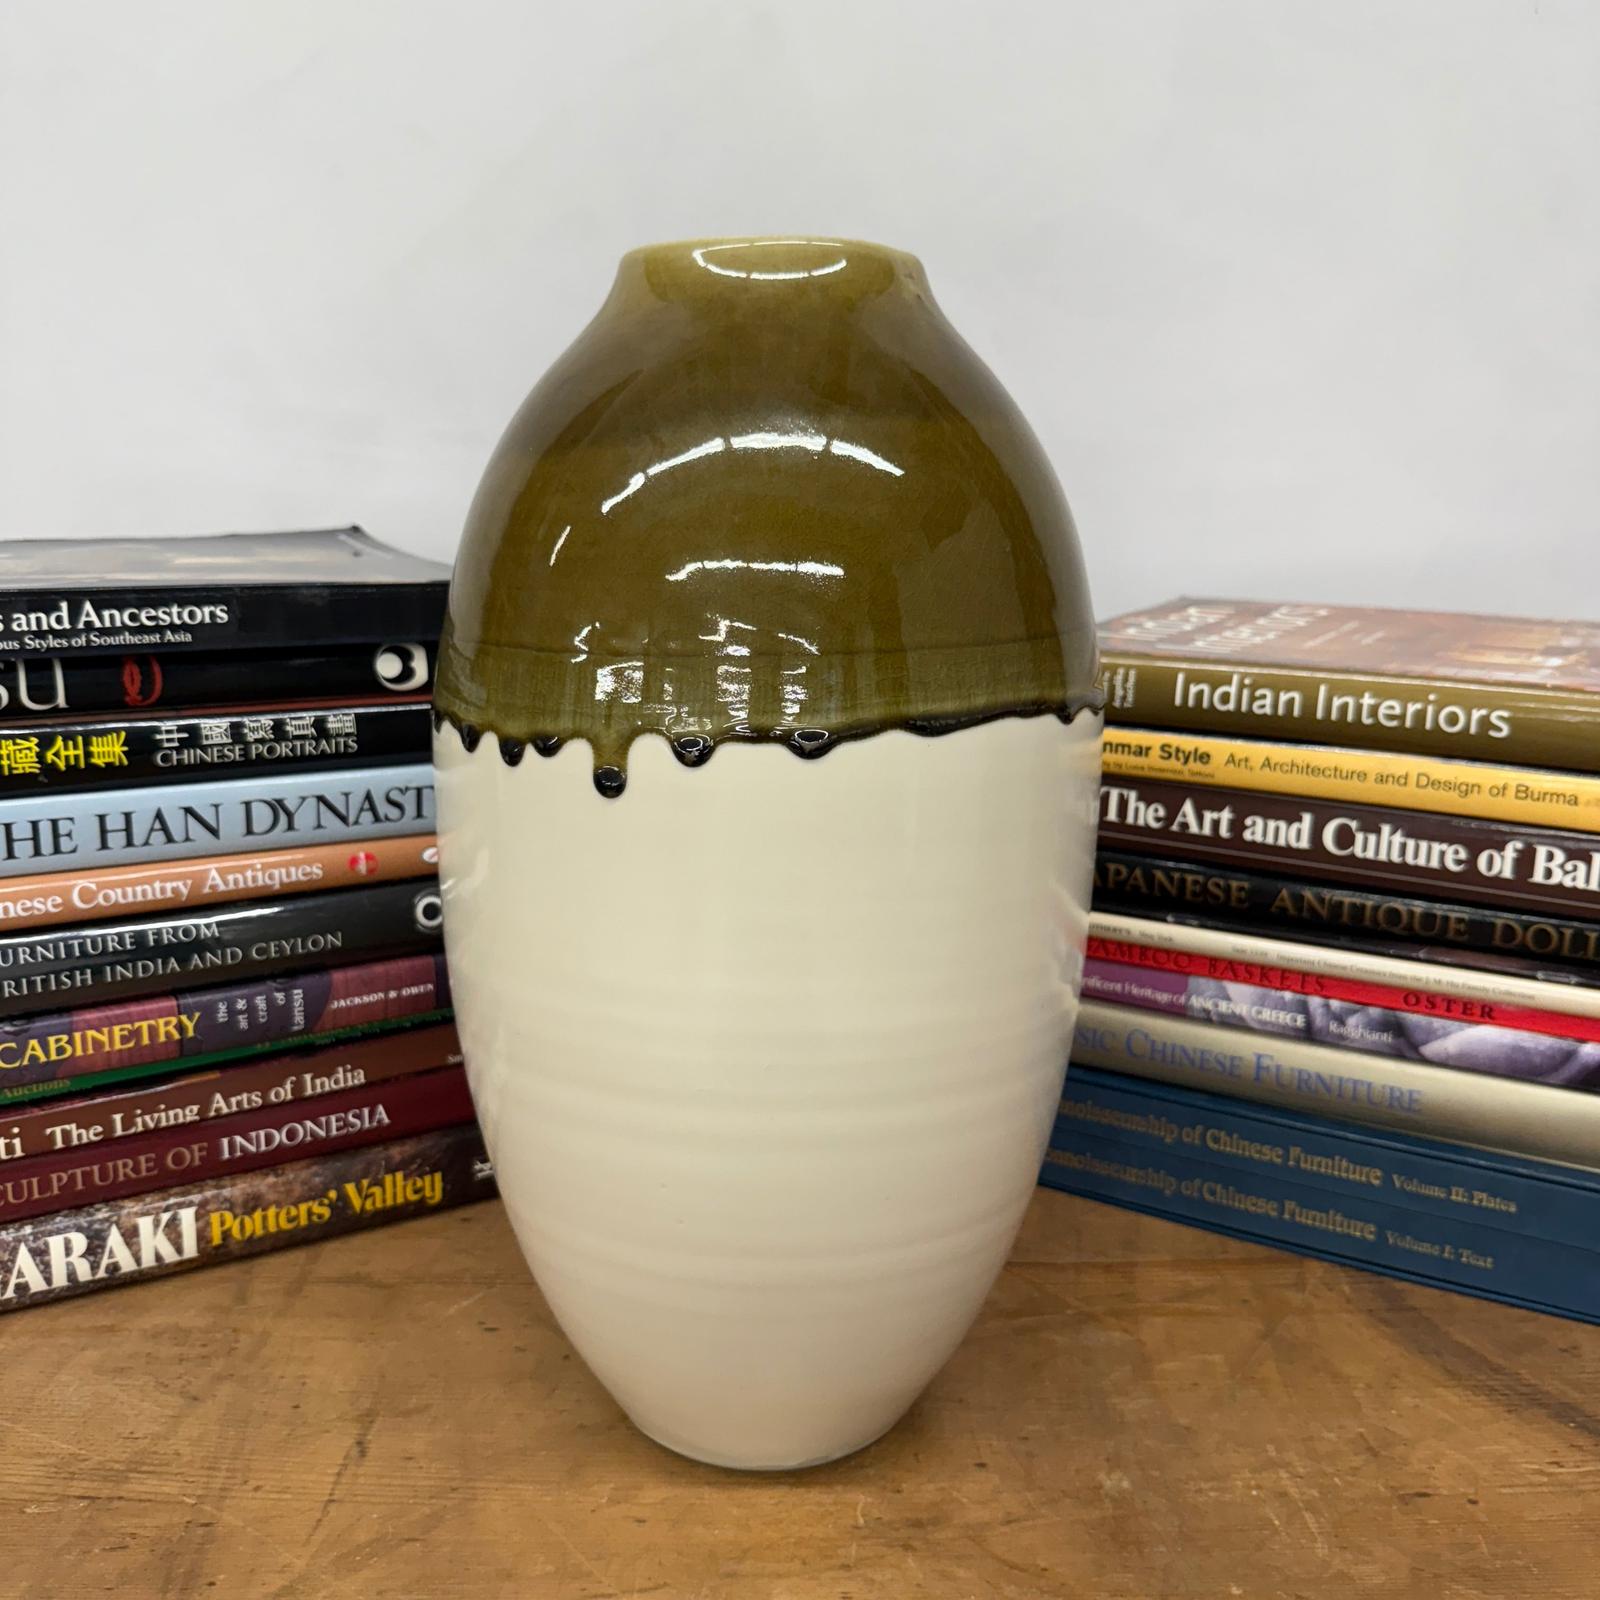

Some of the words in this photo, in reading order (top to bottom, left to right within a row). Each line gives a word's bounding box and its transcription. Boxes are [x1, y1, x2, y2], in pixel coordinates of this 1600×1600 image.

[11, 601, 71, 631] and
[77, 600, 229, 630] Ancestors
[24, 634, 69, 652] Styles
[72, 633, 88, 648] of
[88, 630, 161, 646] Southeast
[164, 630, 193, 643] Asia
[1174, 672, 1303, 719] Indian
[1315, 683, 1513, 739] Interiors
[155, 743, 246, 768] CHINESE
[252, 736, 359, 761] PORTRAITS
[1103, 741, 1152, 758] nmar
[1158, 743, 1212, 766] Style
[1224, 752, 1254, 772] Art,
[1260, 756, 1368, 783] Architecture
[1374, 771, 1409, 788] and
[1416, 772, 1482, 799] Design
[1488, 783, 1509, 799] of
[1514, 783, 1579, 808] Burma
[1, 816, 79, 861] HE
[95, 803, 224, 851] HAN
[241, 786, 435, 838] DYNAST
[1100, 785, 1168, 830] The
[1169, 797, 1237, 840] Art
[1242, 811, 1316, 850] and
[1322, 817, 1471, 873] Culture
[1476, 840, 1524, 880] of
[1527, 844, 1600, 892] Bal
[0, 894, 64, 919] nese
[72, 880, 193, 909] Country
[203, 862, 324, 894] Antiques
[1270, 887, 1470, 941] ANTIQUE
[0, 932, 137, 967] URNITURE
[147, 922, 220, 948] FROM
[3, 968, 93, 998] RITISH
[105, 957, 182, 983] INDIA
[190, 947, 243, 970] AND
[251, 931, 343, 961] CEYLON
[1207, 953, 1325, 993] BASKETS
[331, 991, 385, 1009] JACKSON
[388, 989, 399, 999] &
[402, 983, 434, 997] OWEN
[1189, 994, 1249, 1018] ANCIENT
[1251, 1006, 1307, 1029] GREECE
[1403, 991, 1496, 1021] OSTER
[0, 1011, 201, 1070] CABINETRY
[1125, 1027, 1244, 1078] CHINESE
[1253, 1051, 1424, 1115] FURNITURE
[45, 1122, 104, 1150] The
[112, 1104, 200, 1138] Living
[208, 1091, 263, 1117] Arts
[270, 1076, 297, 1103] of
[302, 1064, 367, 1097] India
[0, 1152, 158, 1206] ULPTURE
[166, 1142, 210, 1171] OF
[218, 1104, 392, 1161] INDONESIA
[1182, 1124, 1205, 1145] of
[1205, 1128, 1284, 1165] Chinese
[1287, 1146, 1383, 1187] Furniture
[1391, 1173, 1447, 1199] Volume
[1471, 1190, 1518, 1214] Plates
[1, 1206, 200, 1300] ARAKI
[208, 1190, 338, 1248] Potters'
[343, 1169, 445, 1215] Valley
[1180, 1177, 1201, 1199] of
[1202, 1181, 1279, 1217] Chinese
[1283, 1199, 1378, 1242] Furniture
[1386, 1230, 1441, 1257] Volume
[1458, 1247, 1496, 1270] Text
